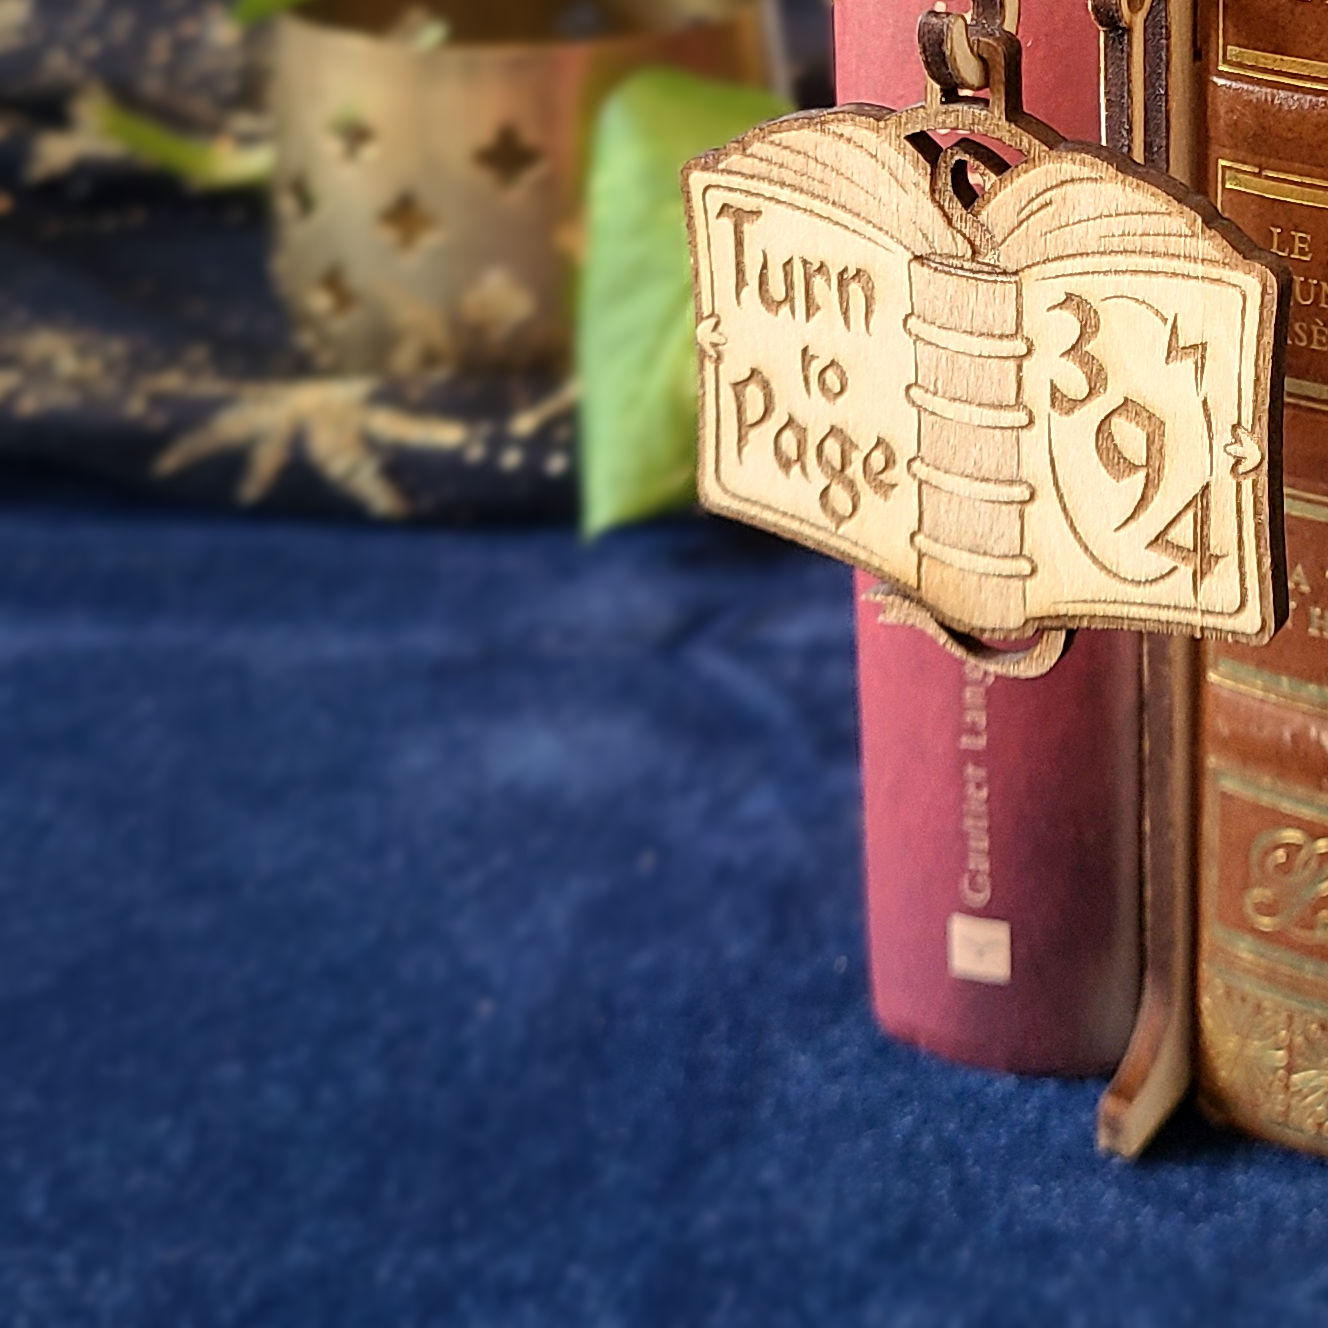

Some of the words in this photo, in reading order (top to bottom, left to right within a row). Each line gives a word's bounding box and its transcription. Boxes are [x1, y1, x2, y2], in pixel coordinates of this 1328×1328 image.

[715, 202, 876, 336] Turn
[1269, 225, 1313, 262] LE
[729, 366, 899, 532] Page
[1287, 562, 1312, 595] A
